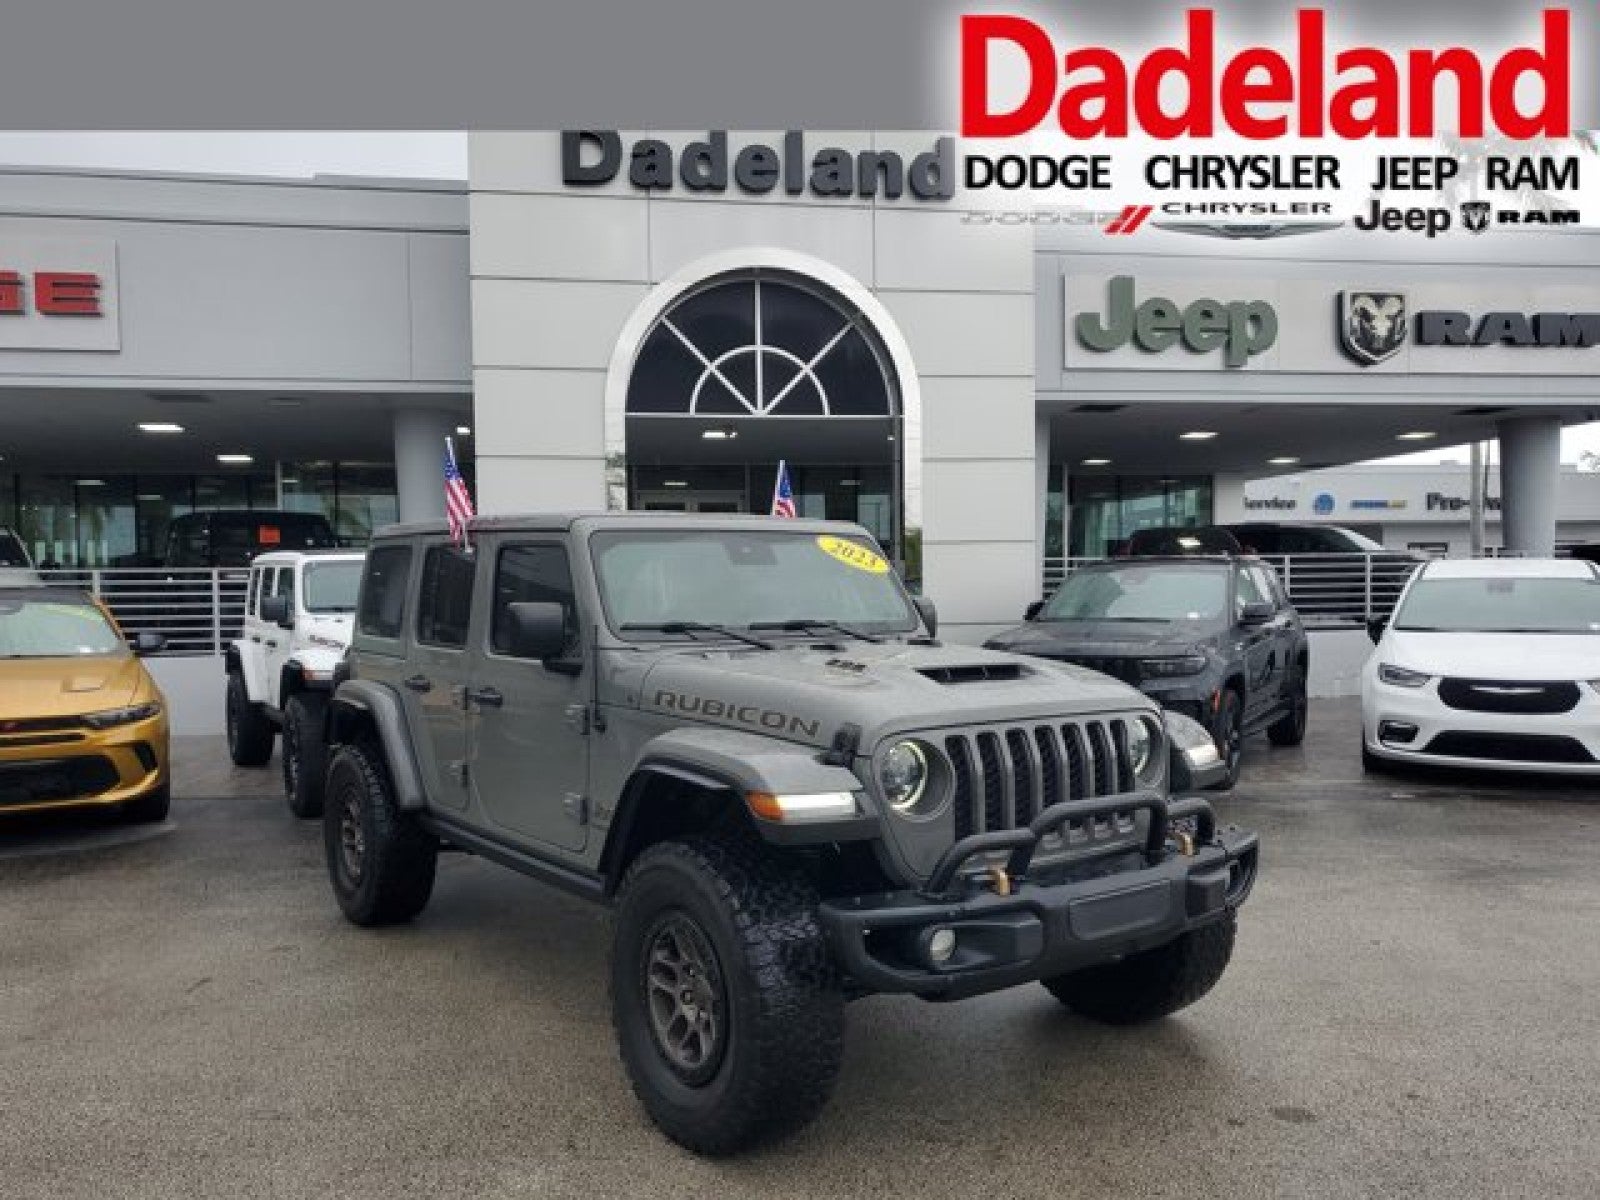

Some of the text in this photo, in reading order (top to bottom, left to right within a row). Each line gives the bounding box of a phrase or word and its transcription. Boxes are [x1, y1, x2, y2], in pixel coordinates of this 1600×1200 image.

[562, 130, 956, 202] Dadeland
[1077, 276, 1278, 367] Jeep
[1415, 310, 1600, 346] RAM
[655, 689, 821, 737] RUBICON
